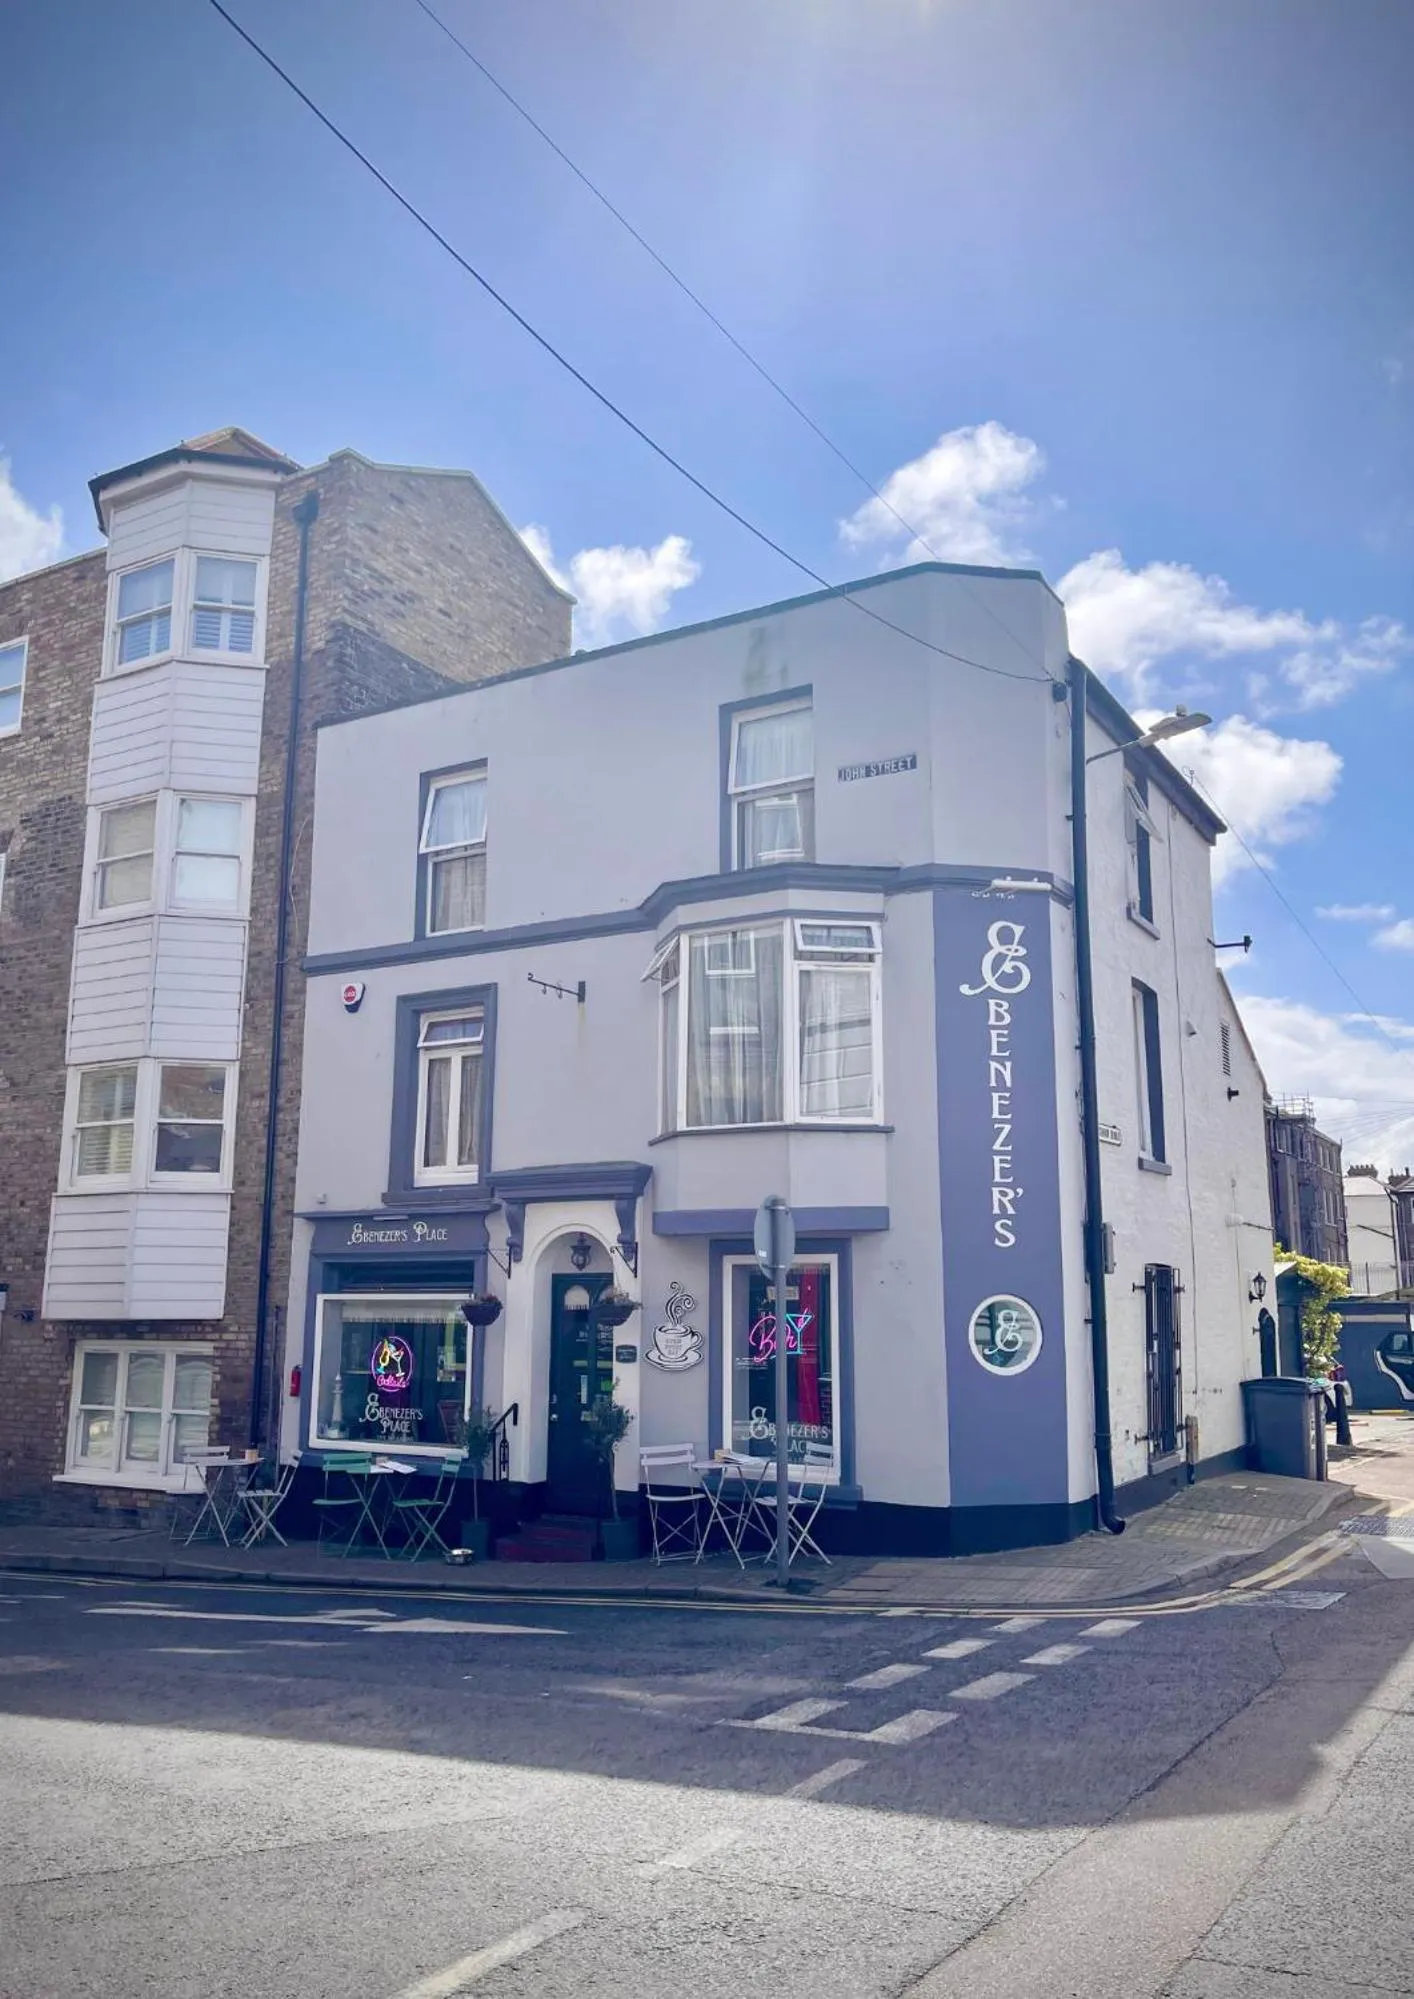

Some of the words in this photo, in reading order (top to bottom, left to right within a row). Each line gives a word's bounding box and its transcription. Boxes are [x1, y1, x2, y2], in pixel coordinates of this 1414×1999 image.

[839, 767, 865, 781] JOHN
[870, 755, 914, 777] STREET
[413, 1221, 448, 1243] PLACE
[380, 1417, 411, 1434] PLACE
